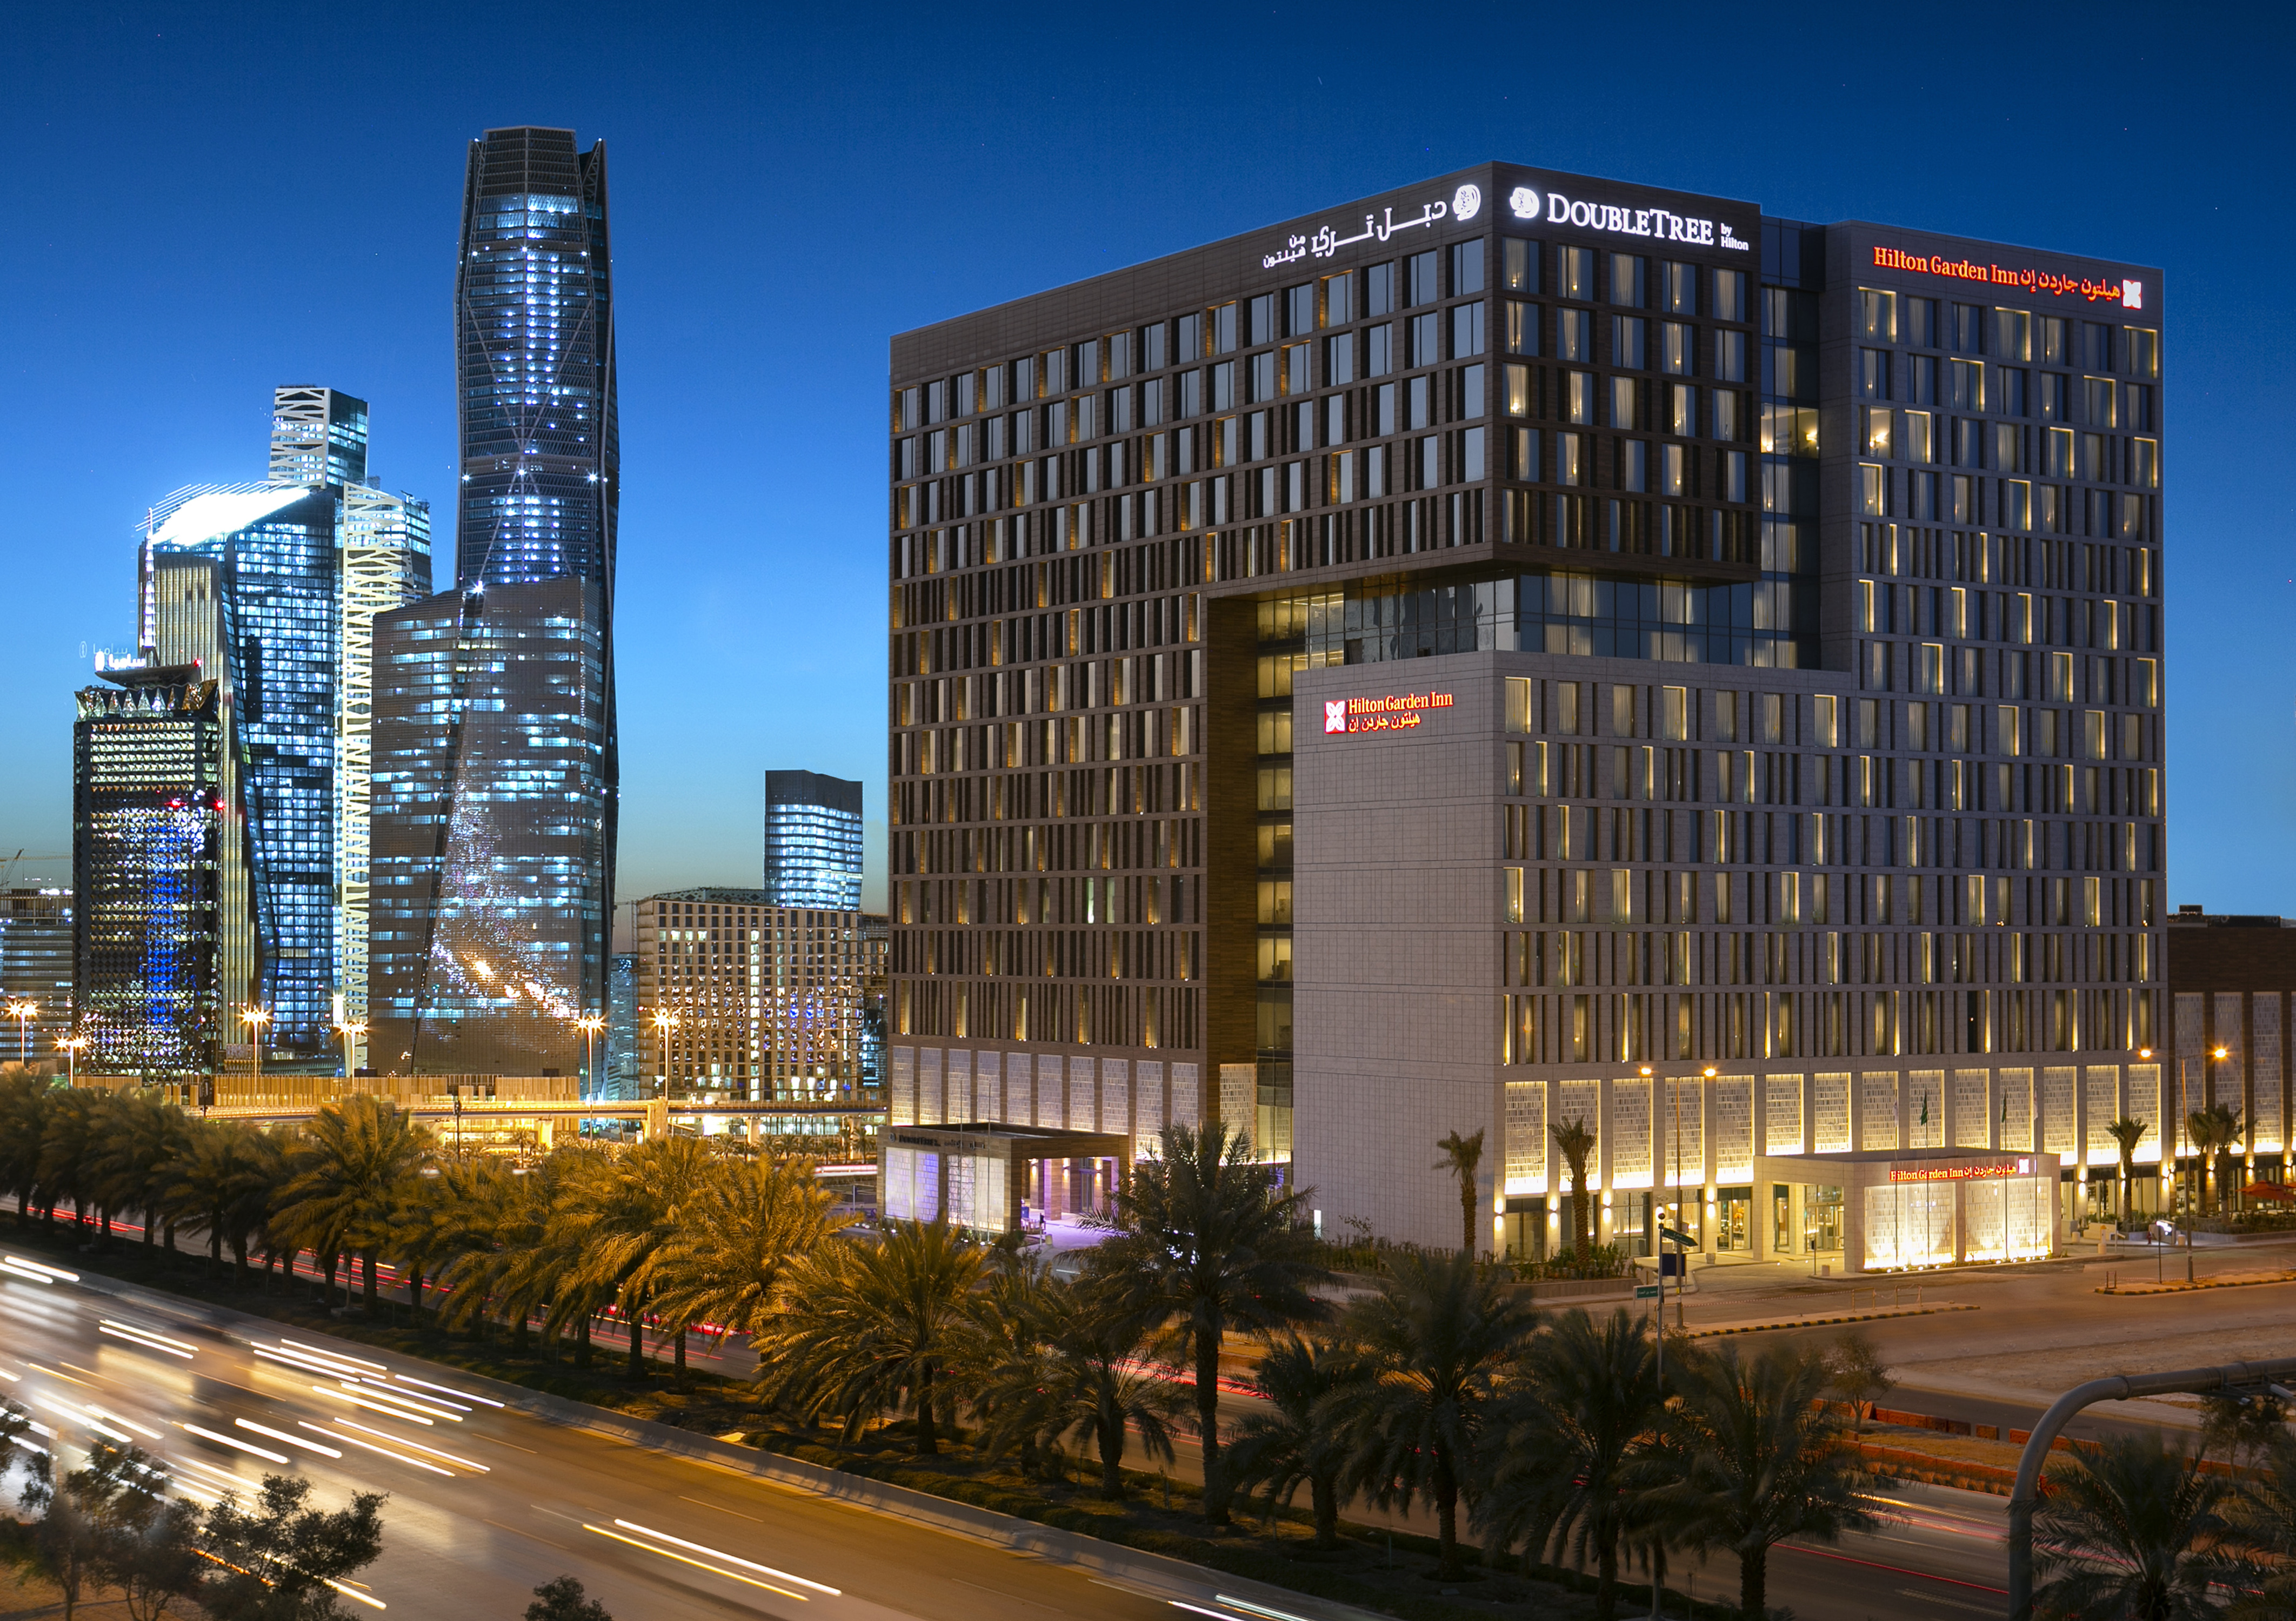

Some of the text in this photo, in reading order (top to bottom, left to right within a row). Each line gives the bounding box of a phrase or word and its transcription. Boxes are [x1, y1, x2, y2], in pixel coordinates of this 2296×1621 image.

[1376, 201, 1447, 241] دبل
[1720, 223, 1732, 236] by
[1289, 234, 1306, 248] من
[1720, 236, 1750, 251] Hilton
[1263, 246, 1306, 269] هيلتون
[1873, 246, 2019, 286] Hilton Garden Inn
[2019, 269, 2121, 303] هيلتون جاردن إن
[1347, 690, 1454, 715] Hilton Garden Inn
[1347, 711, 1421, 733] هيلتون جاردن إن
[1890, 1170, 1918, 1181] Hilton
[1947, 1167, 1964, 1179] Inn
[1963, 1166, 1973, 1179] إن
[1973, 1165, 1995, 1178] جاردن
